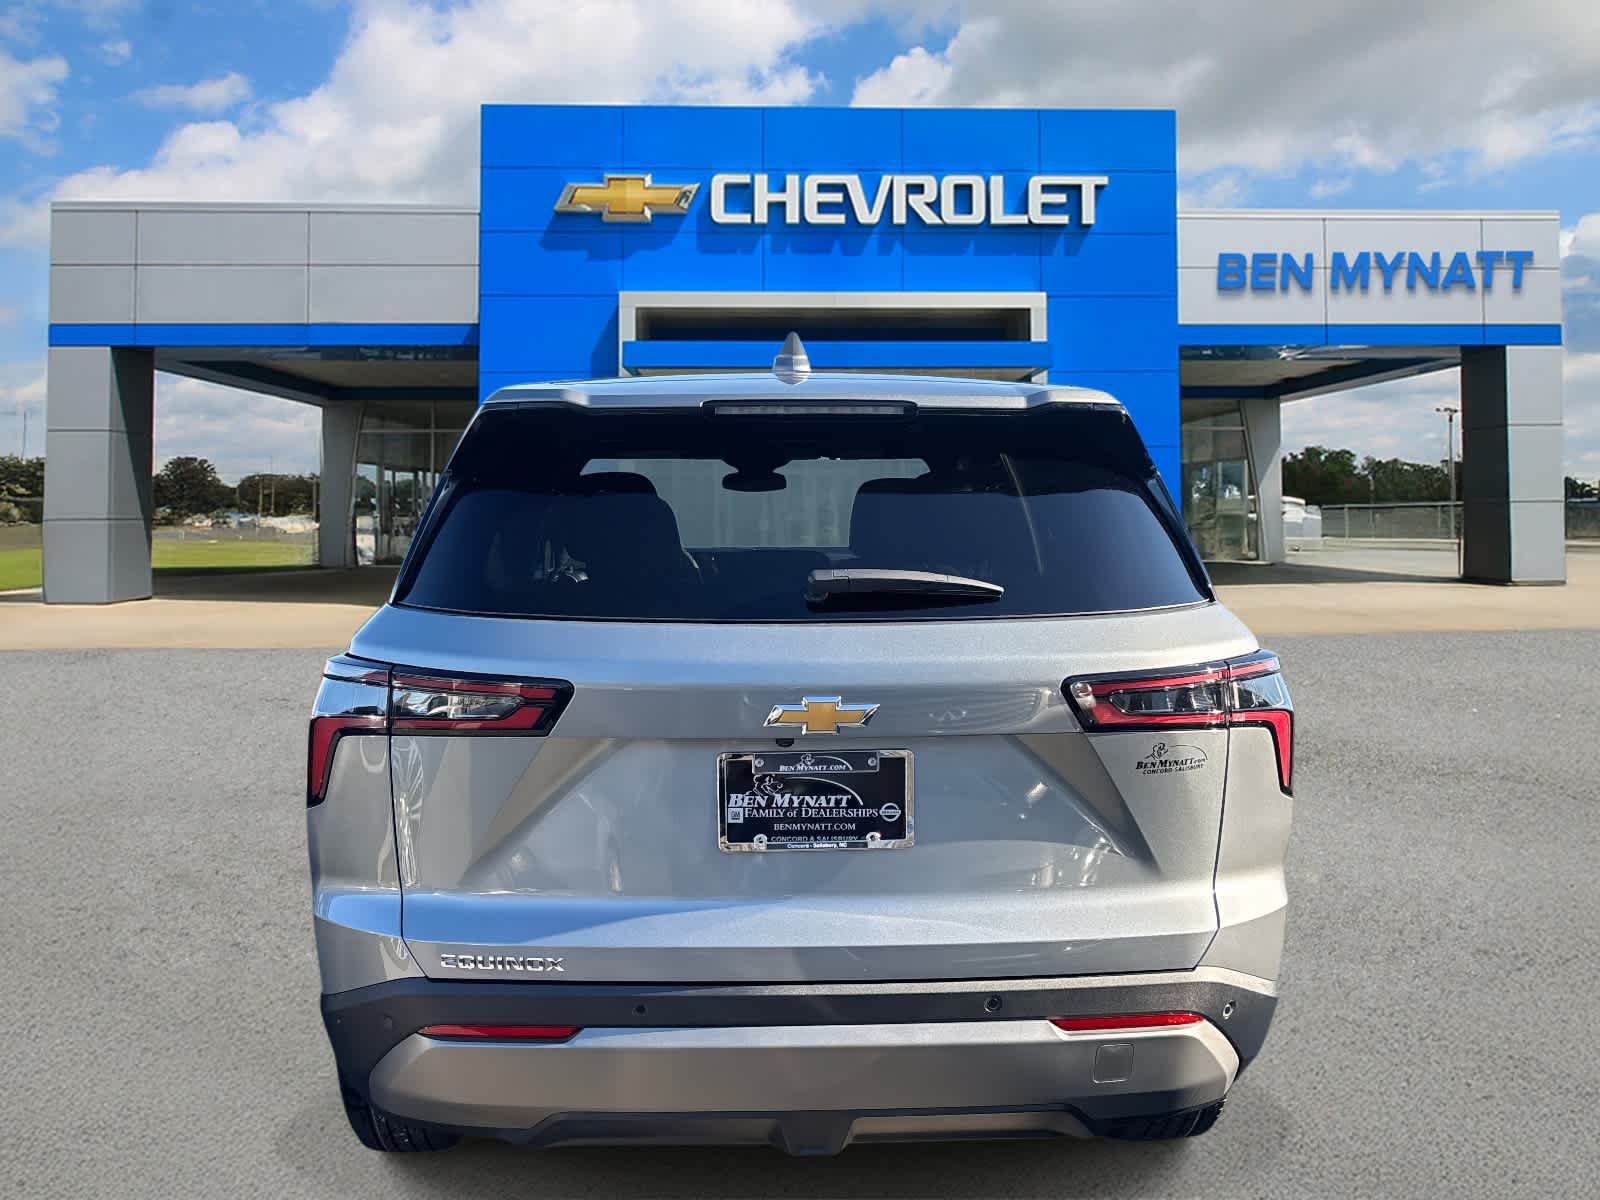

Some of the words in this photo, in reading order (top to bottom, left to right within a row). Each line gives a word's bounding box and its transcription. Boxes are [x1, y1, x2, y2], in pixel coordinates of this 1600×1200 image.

[711, 173, 1109, 225] CHEVROLET
[1217, 252, 1314, 290] BEN
[1330, 250, 1534, 290] MYNATT
[1136, 760, 1157, 769] BEN
[728, 793, 770, 808] BEN
[772, 793, 852, 808] MYNATT
[744, 807, 785, 818] FAMILY
[786, 808, 800, 818] of
[801, 807, 879, 818] DEALERSHIPS
[774, 823, 856, 831] BENMYNATT.COM
[440, 953, 566, 972] EQUINOX
